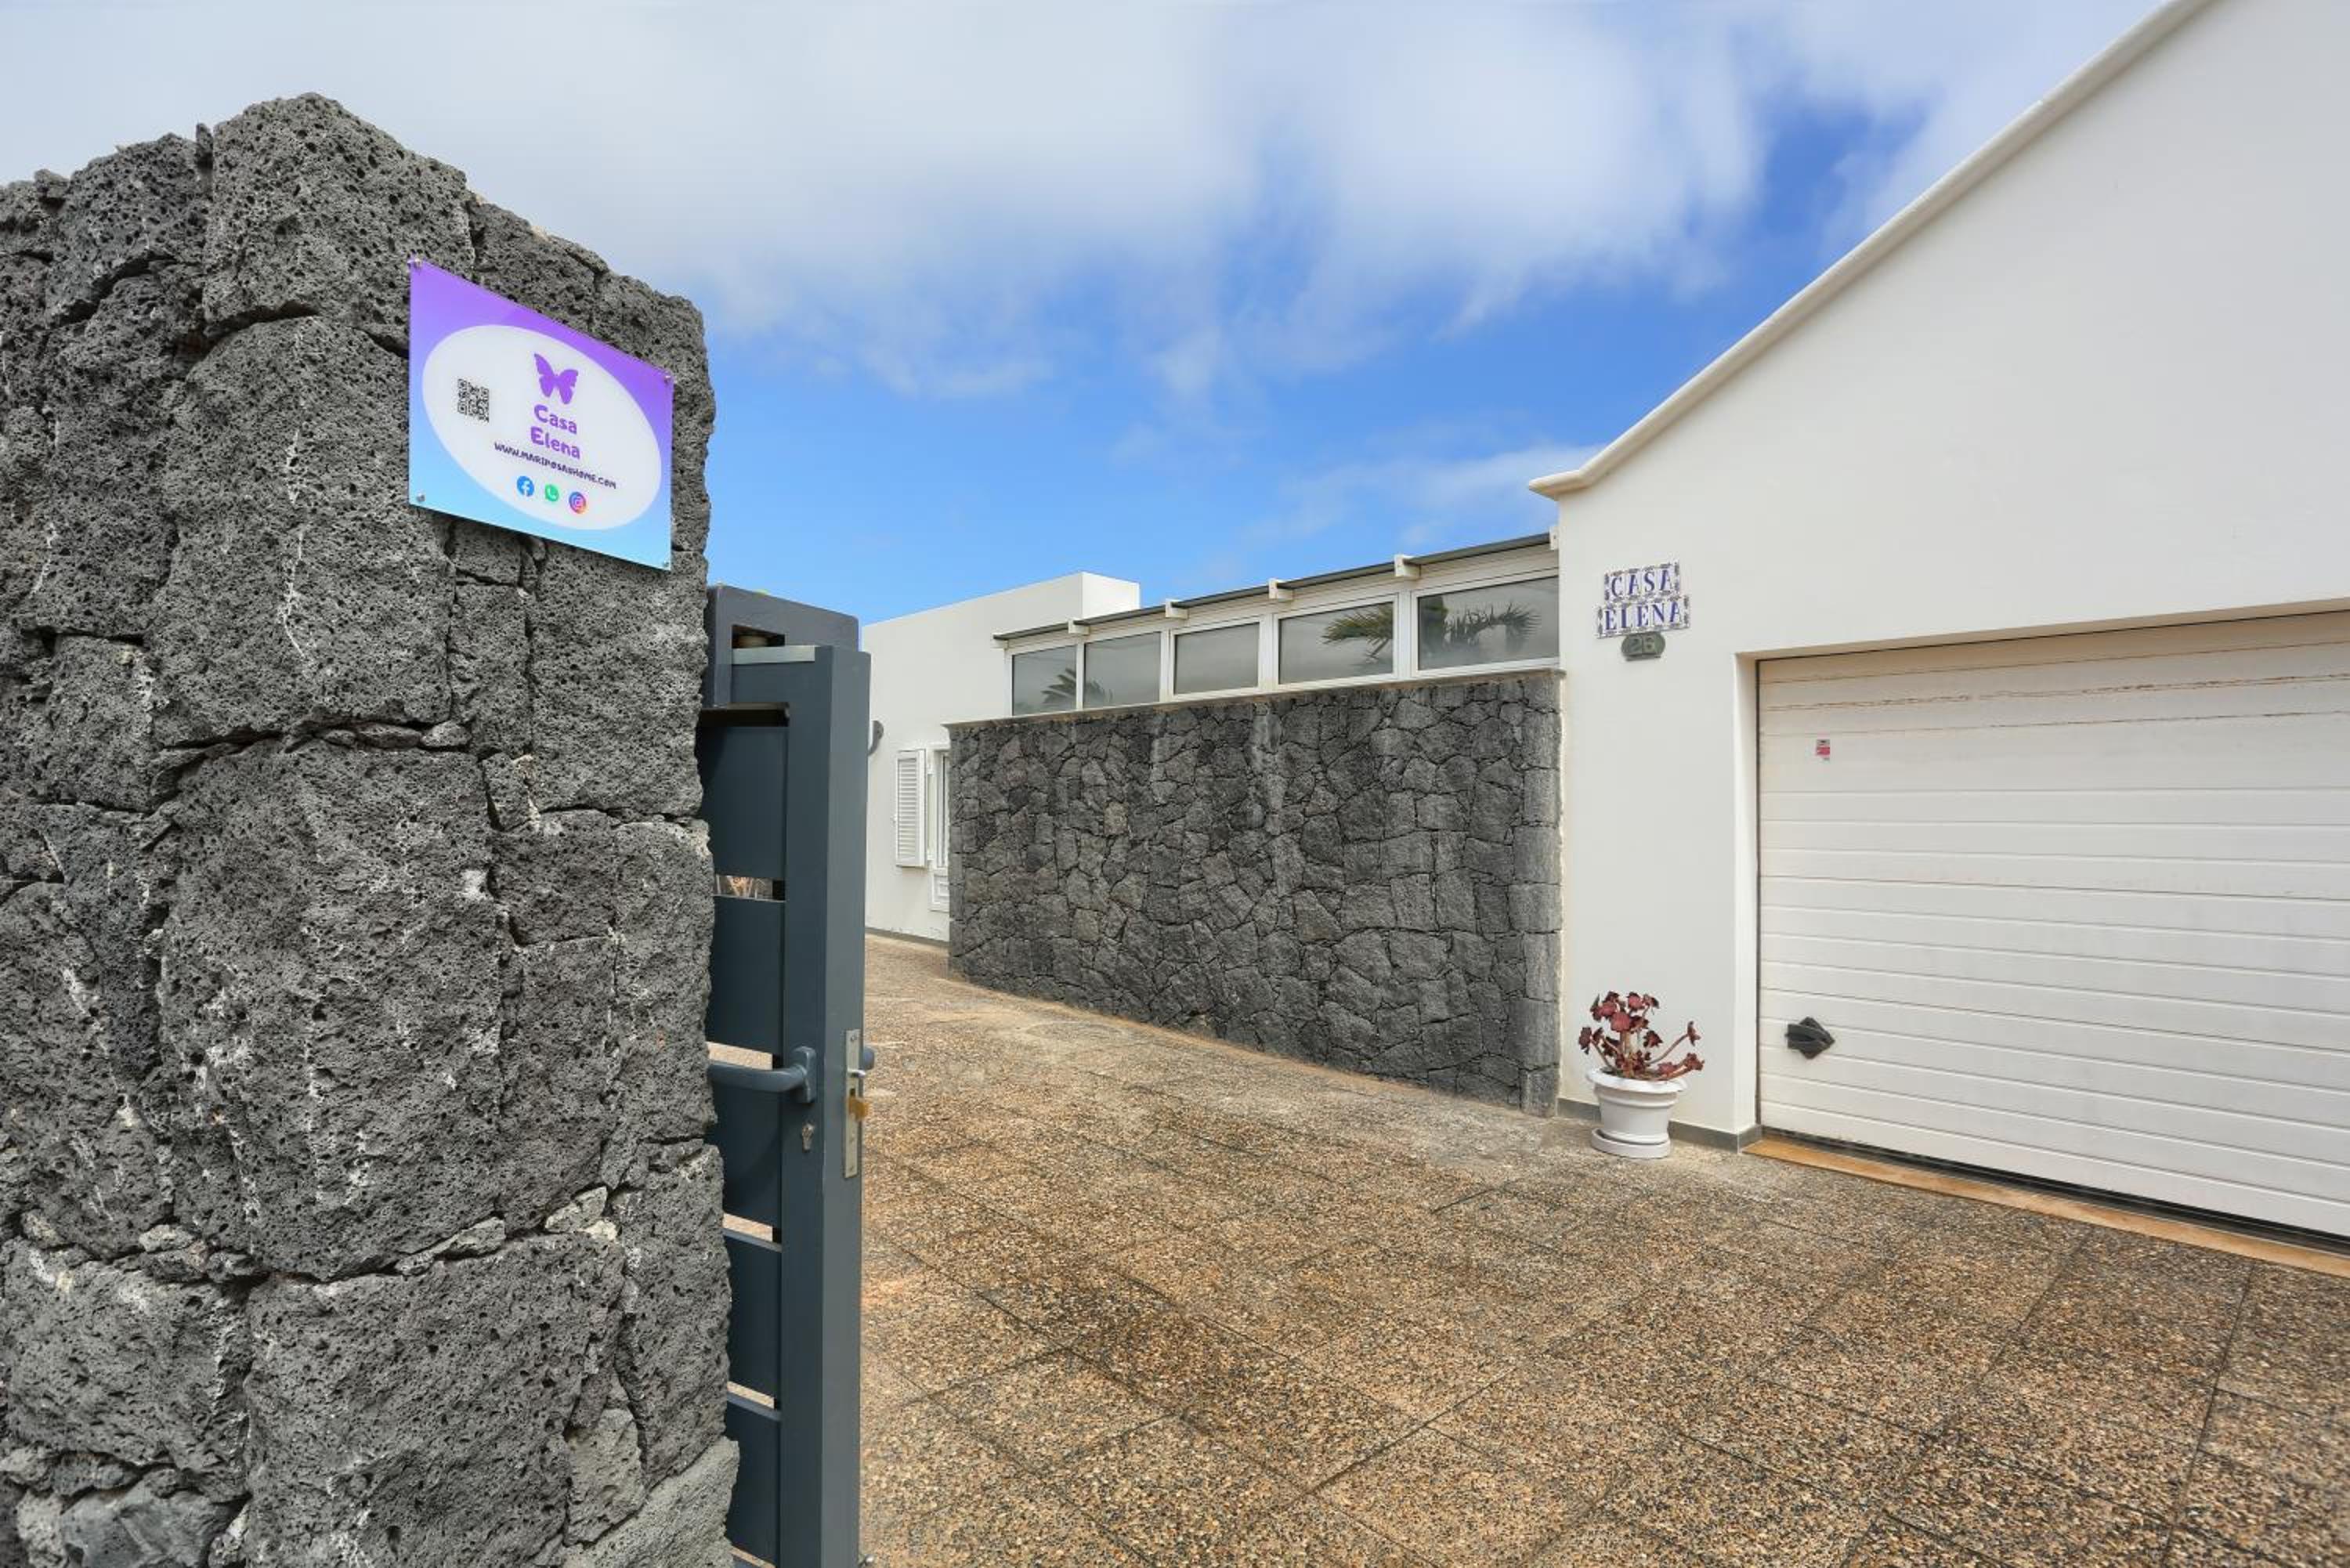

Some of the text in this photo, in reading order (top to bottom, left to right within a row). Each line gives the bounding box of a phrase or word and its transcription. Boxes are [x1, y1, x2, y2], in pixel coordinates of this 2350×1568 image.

[534, 404, 577, 435] Casa
[530, 426, 580, 460] Elena
[1611, 569, 1672, 598] CASA
[1604, 601, 1682, 630] ELENA
